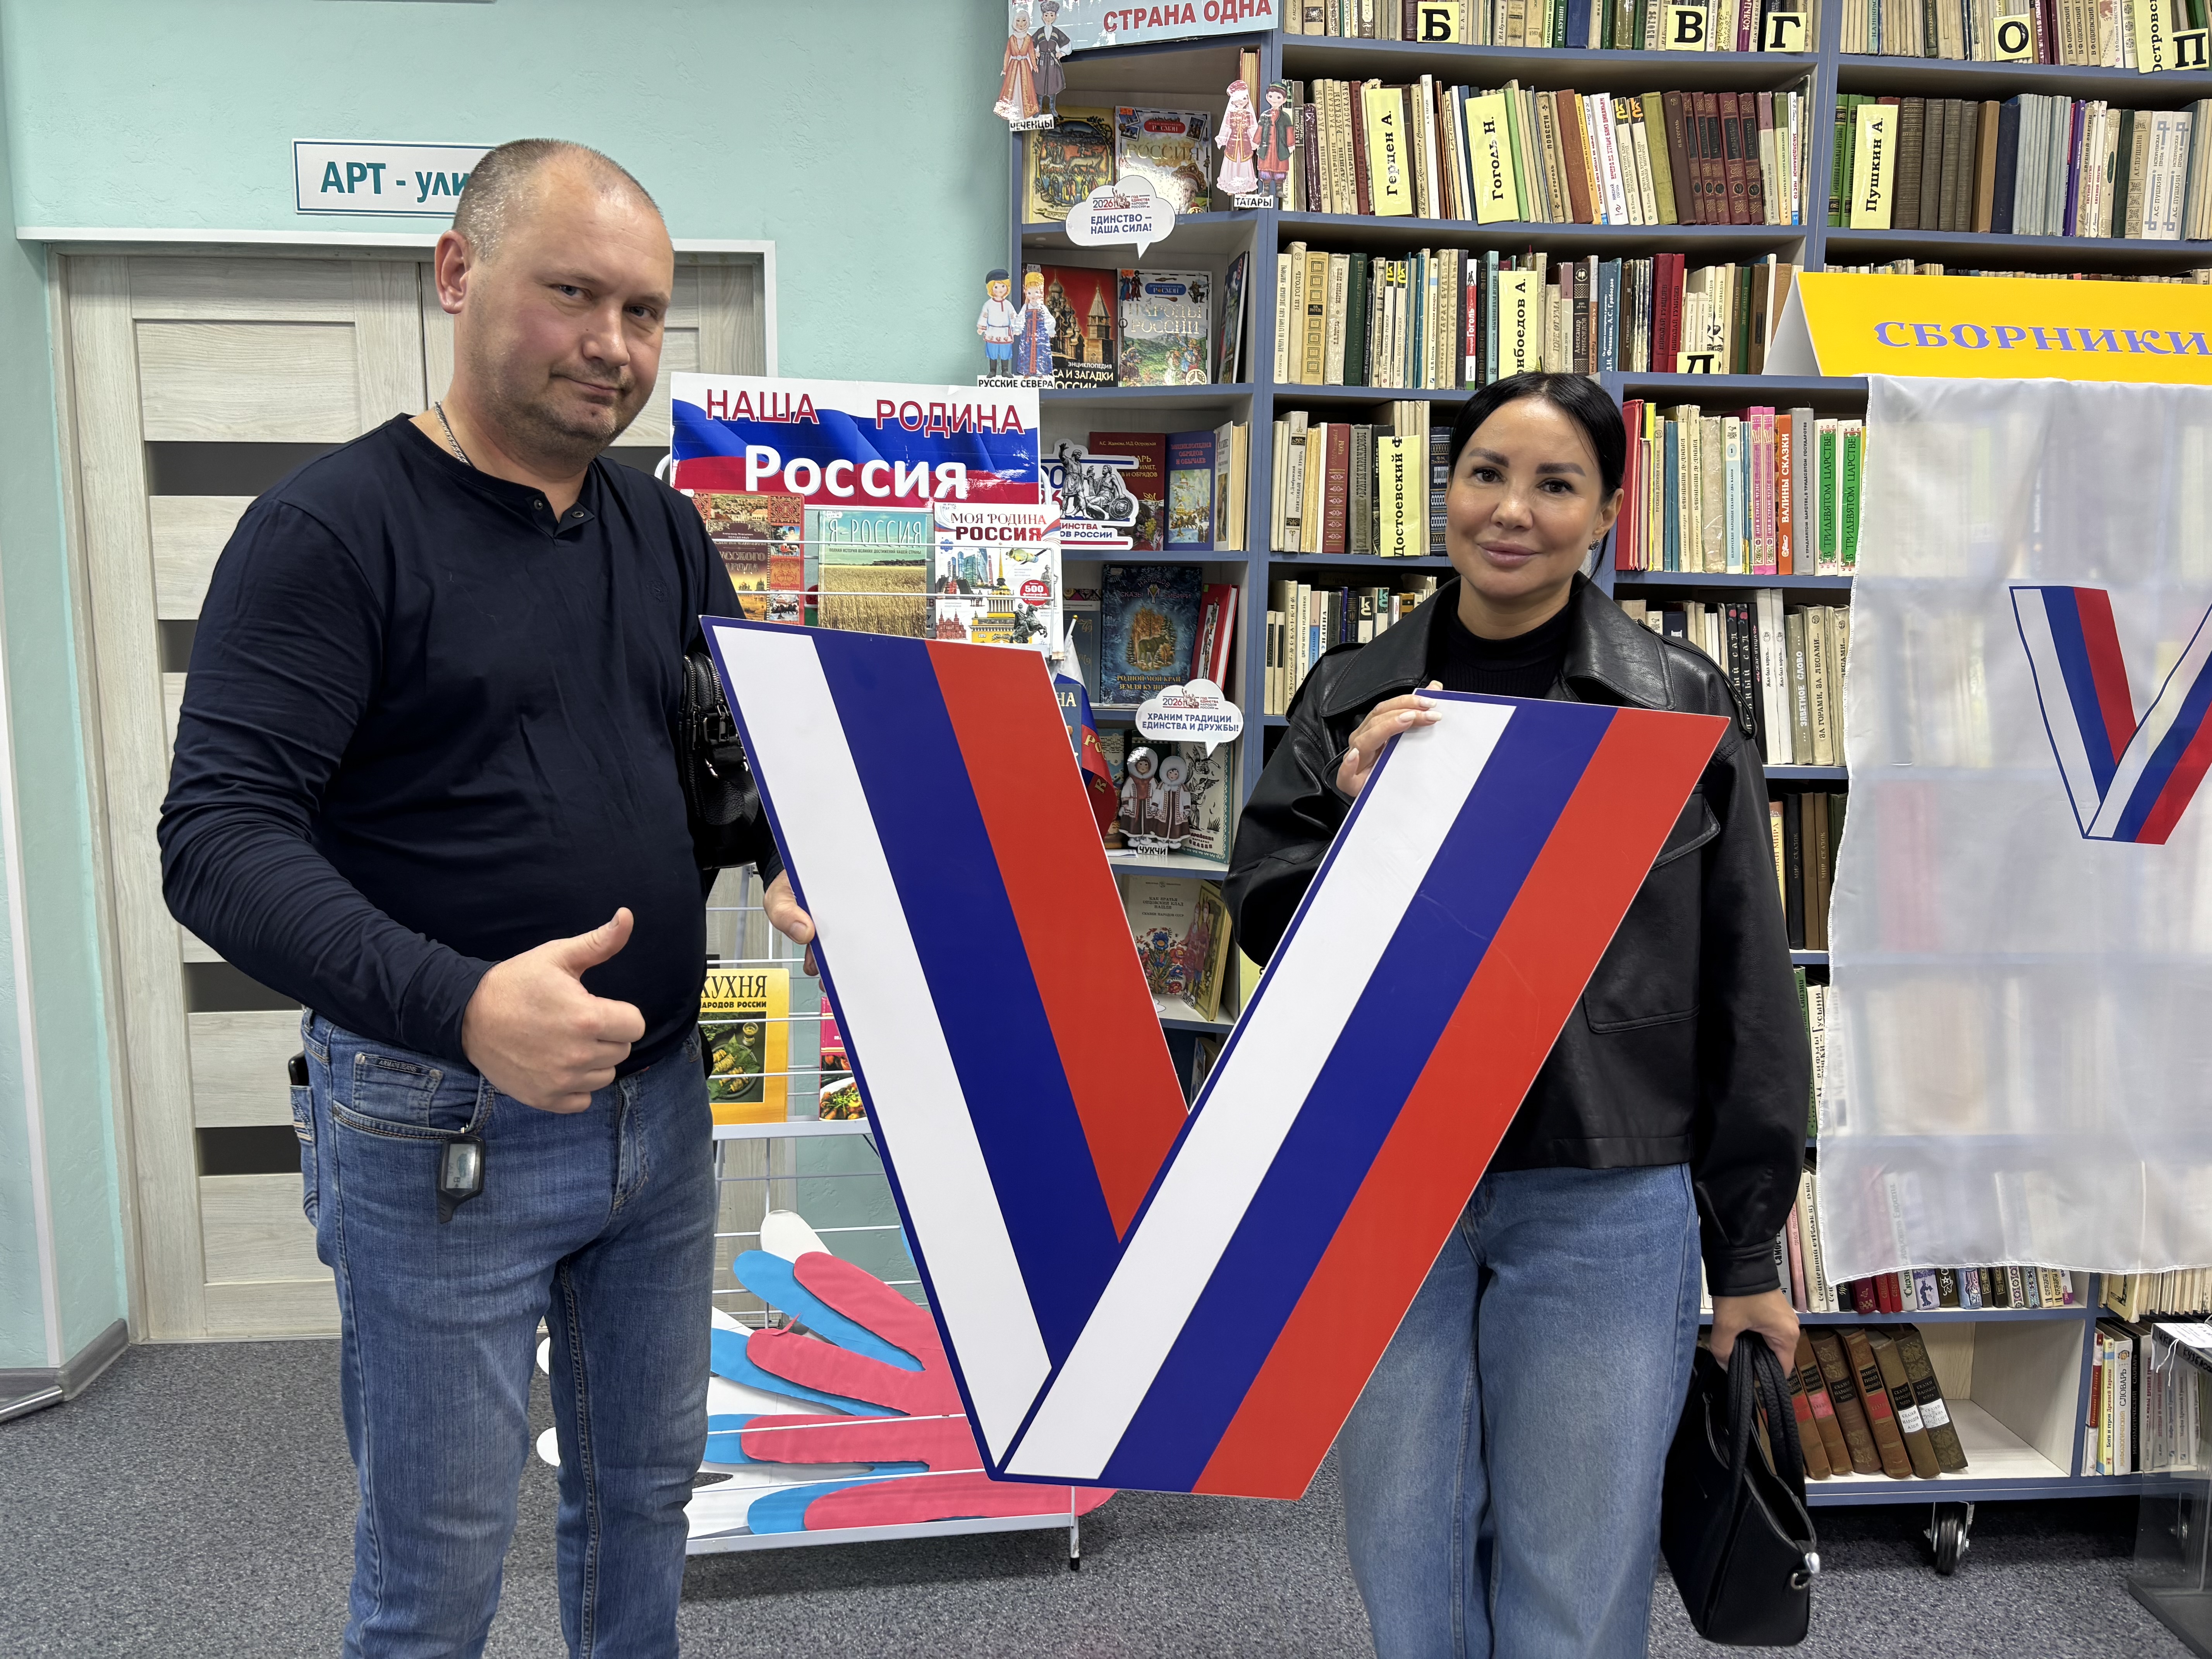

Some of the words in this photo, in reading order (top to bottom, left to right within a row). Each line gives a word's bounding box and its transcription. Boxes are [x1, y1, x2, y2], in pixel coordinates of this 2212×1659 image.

[1104, 3, 1197, 32] СТРАНА
[1204, 0, 1272, 21] ОДНА
[1422, 9, 1451, 41] Б
[1674, 11, 1703, 43] В
[1770, 16, 1801, 48] Г
[2064, 6, 2072, 42] ОДОЕВСКИЙ
[1998, 21, 2029, 53] О
[2150, 0, 2162, 71] Островс
[2173, 33, 2206, 68] П
[1316, 89, 1324, 132] РАССКАЗЫ
[1326, 86, 1335, 128] РАССКАЗЫ
[1334, 91, 1342, 134] РАССКАЗЫ
[1342, 84, 1351, 127] РАССКАЗЫ
[1381, 111, 1392, 125] А.
[1599, 98, 1608, 123] ДИКАНЬКИ
[1010, 119, 1053, 131] ЧЕЧЕНЦЫ
[1483, 117, 1495, 134] Н.
[1543, 115, 1553, 149] ПОВЕСТИ
[1872, 118, 1883, 133] А.
[1126, 141, 1200, 161] РОССИЯ
[1385, 132, 1399, 196] Герцен
[2134, 135, 2142, 177] А.С.ПУШКИН
[320, 161, 386, 194] АРТ
[415, 171, 470, 203] ули
[1489, 140, 1503, 200] Гоголь
[1865, 138, 1882, 212] Пушкин
[1093, 199, 1113, 208] 2026
[1235, 197, 1272, 207] ТАТАРЫ
[1091, 214, 1142, 225] ЕДИНСТВО
[1091, 225, 1120, 235] НАША
[1122, 223, 1152, 233] СИЛА!
[1515, 278, 1526, 294] А.
[1128, 302, 1202, 318] НАРОДЫ
[1131, 317, 1199, 334] РОССИИ
[1467, 308, 1475, 337] Гоголь
[1513, 299, 1526, 374] ибоедов
[1874, 321, 2212, 355] СБОРНИКИ
[978, 379, 1018, 388] РУССКИЕ
[1020, 379, 1054, 388] СЕВЕРА
[1075, 371, 1114, 382] ЗАГАДКИ
[707, 389, 819, 424] НАША
[876, 400, 1025, 438] РОДИНА
[1357, 432, 1367, 472] КАРАМАЗОВЫ
[1781, 433, 1790, 475] СКАЗКИ
[1824, 436, 1832, 479] ЦАРСТВЕ
[1847, 438, 1856, 481] ЦАРСТВЕ
[745, 445, 967, 499] Россия
[1357, 472, 1367, 496] БРАТЬЯ
[1391, 452, 1406, 556] Достоевский
[1781, 478, 1790, 523] ВАЛИНЫ
[1824, 484, 1832, 548] ТРИДЕВЯТОМ
[951, 513, 983, 524] МОЯ
[988, 513, 1047, 526] РОДИНА
[956, 527, 1042, 541] РОССИЯ
[1846, 486, 1855, 550] ТРИДЕВЯТОМ
[721, 551, 766, 562] УССКОГО
[727, 563, 759, 572] АРОДА
[1025, 585, 1044, 593] 500
[1796, 651, 1804, 680] СЛОВО
[1815, 678, 1822, 689] ЗА
[1147, 713, 1183, 721] ХРАНИМ
[1185, 714, 1231, 723] ТРАДИЦИИ
[1163, 698, 1183, 706] 2026
[1798, 685, 1808, 727] ЗАВЕТНОЕ
[1816, 692, 1824, 725] ГОРАМИ,
[1143, 721, 1187, 730] ЕДИНСТВА
[1197, 723, 1239, 732] ДРУЖБЫ!
[1819, 728, 1826, 738] ЗА
[1139, 846, 1166, 855] ЧУКЧИ
[1812, 993, 1824, 1033] Гусыни
[2119, 1369, 2127, 1407] СЛОВАРЬ
